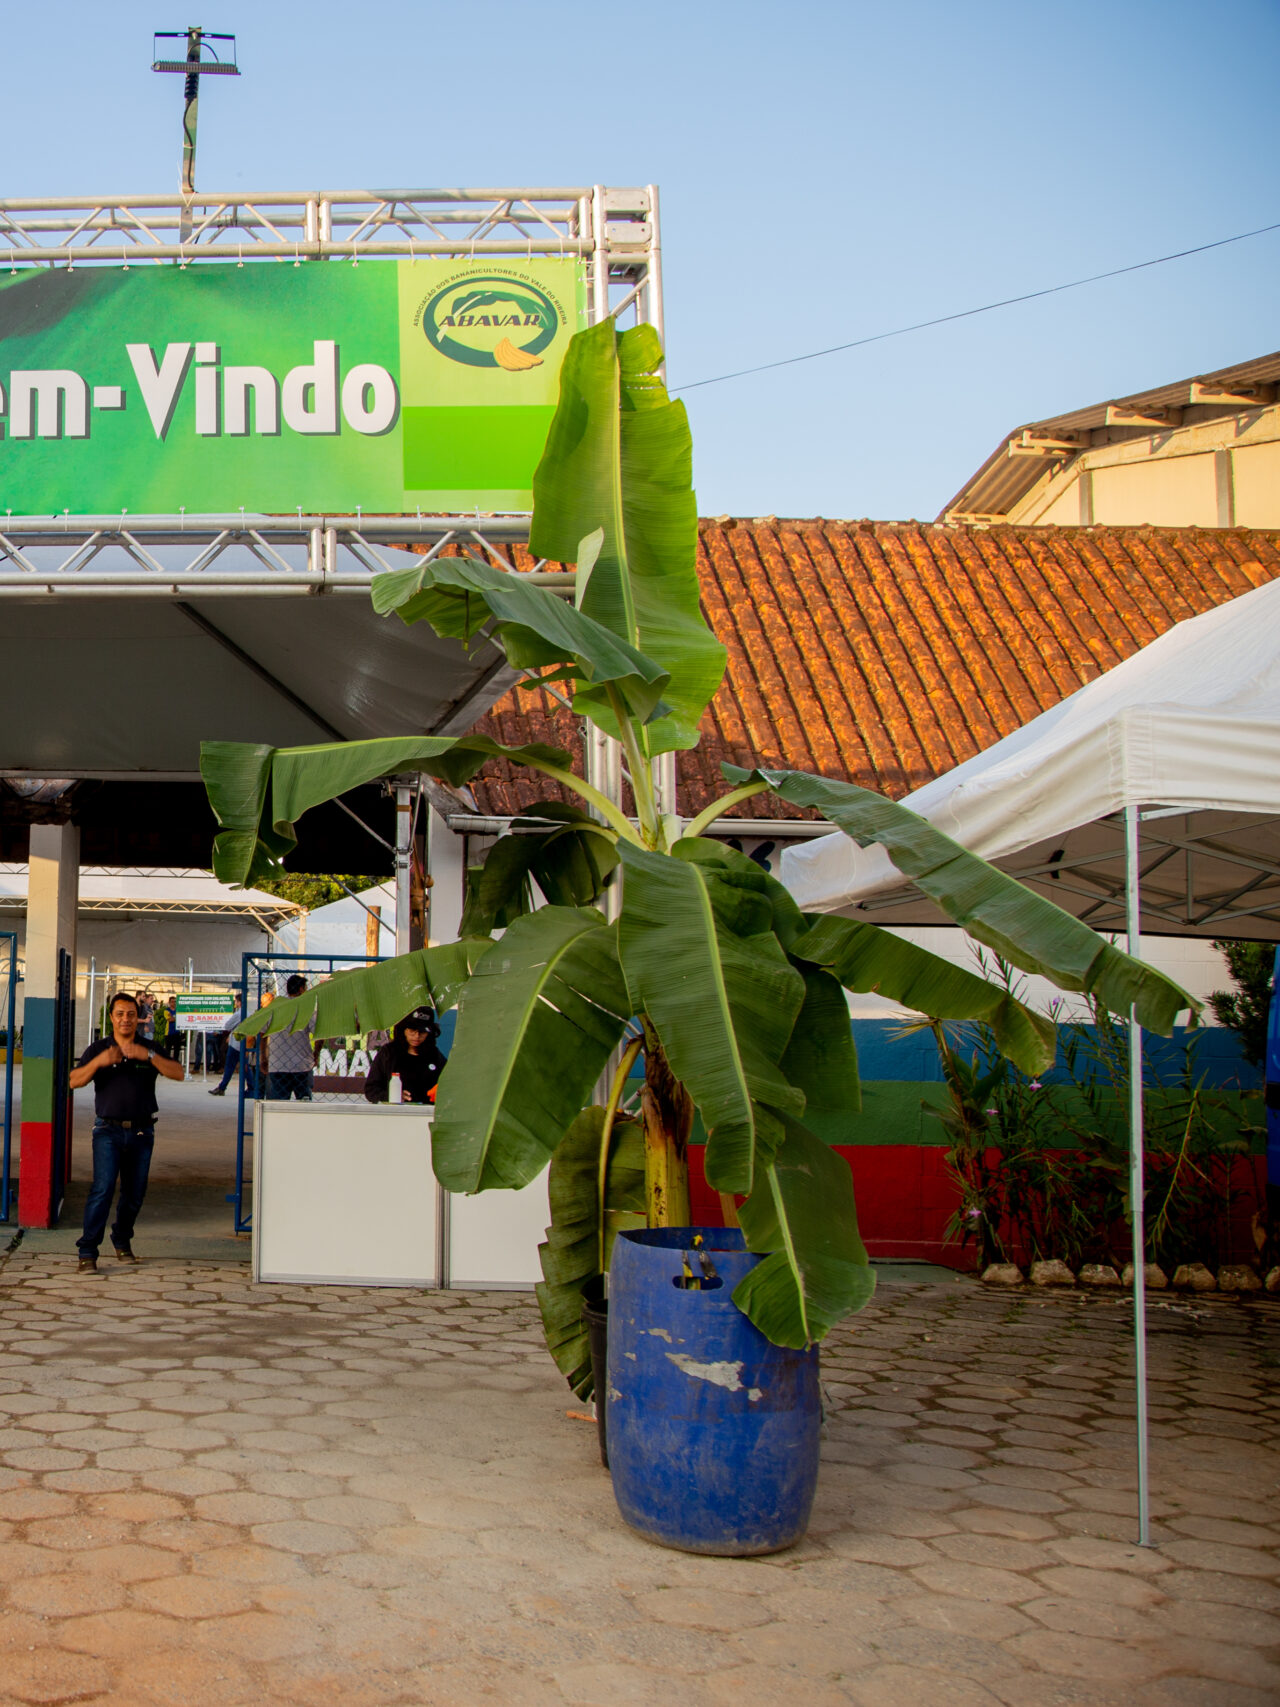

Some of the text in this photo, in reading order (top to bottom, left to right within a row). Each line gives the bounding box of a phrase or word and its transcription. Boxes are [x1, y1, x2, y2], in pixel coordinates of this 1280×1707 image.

[436, 279, 450, 290] DOS
[519, 273, 530, 281] DO
[531, 278, 547, 291] VALE
[553, 299, 568, 326] RIBEIRA
[438, 314, 541, 327] ABAVAR
